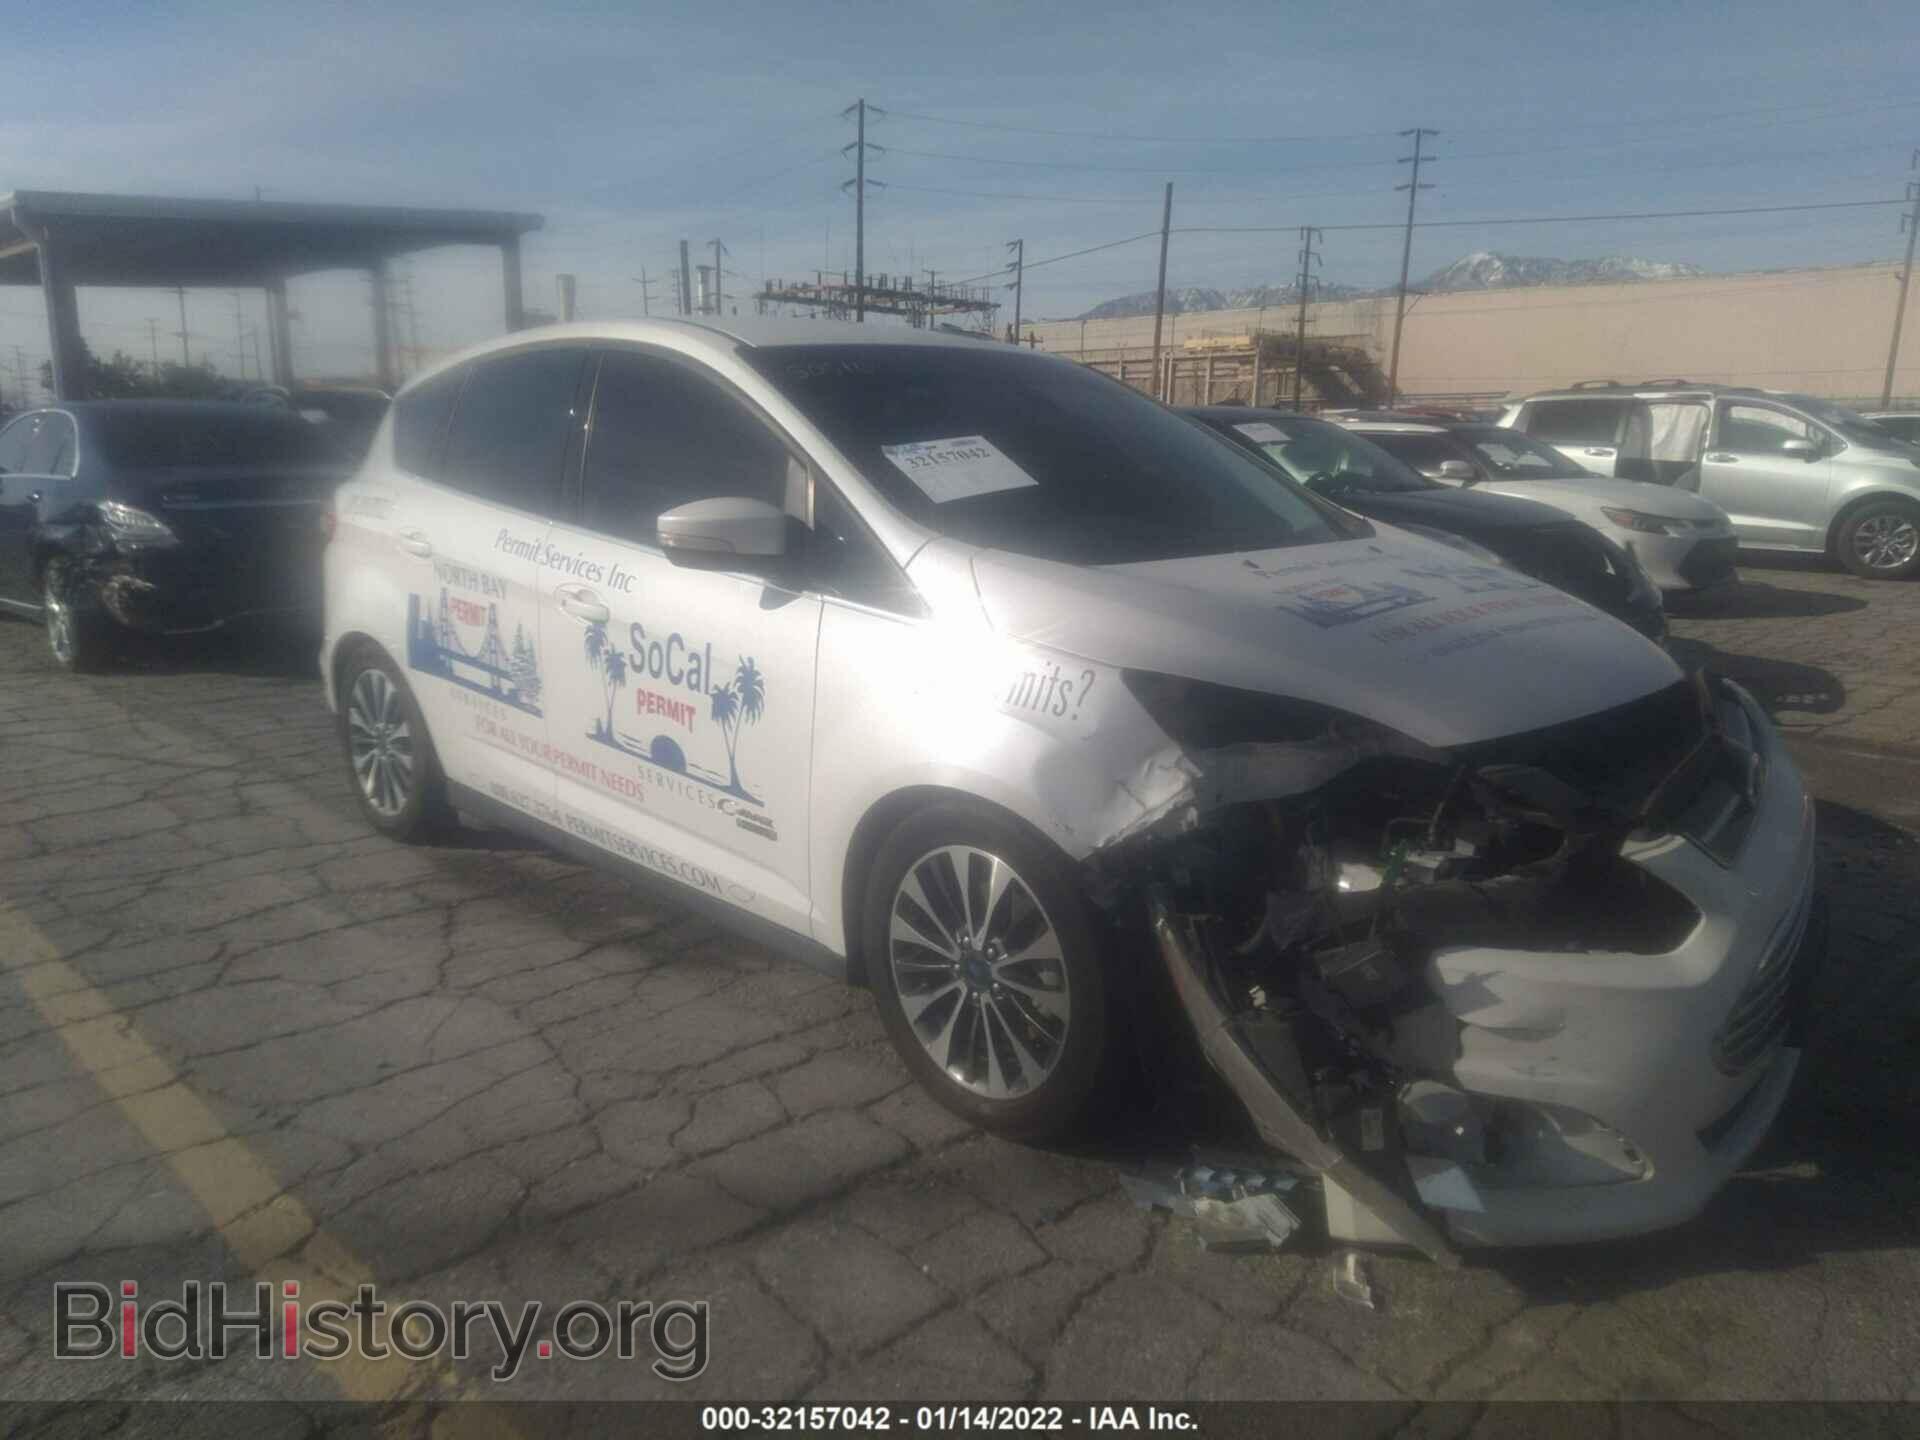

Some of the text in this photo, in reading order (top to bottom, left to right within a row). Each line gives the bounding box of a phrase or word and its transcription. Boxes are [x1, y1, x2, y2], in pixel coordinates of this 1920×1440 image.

[494, 528, 637, 593] Permit Services Inc
[629, 621, 712, 695] SoCal
[636, 687, 697, 734] PERMIT
[600, 769, 645, 802] NEEDS
[638, 765, 716, 809] SERVICES
